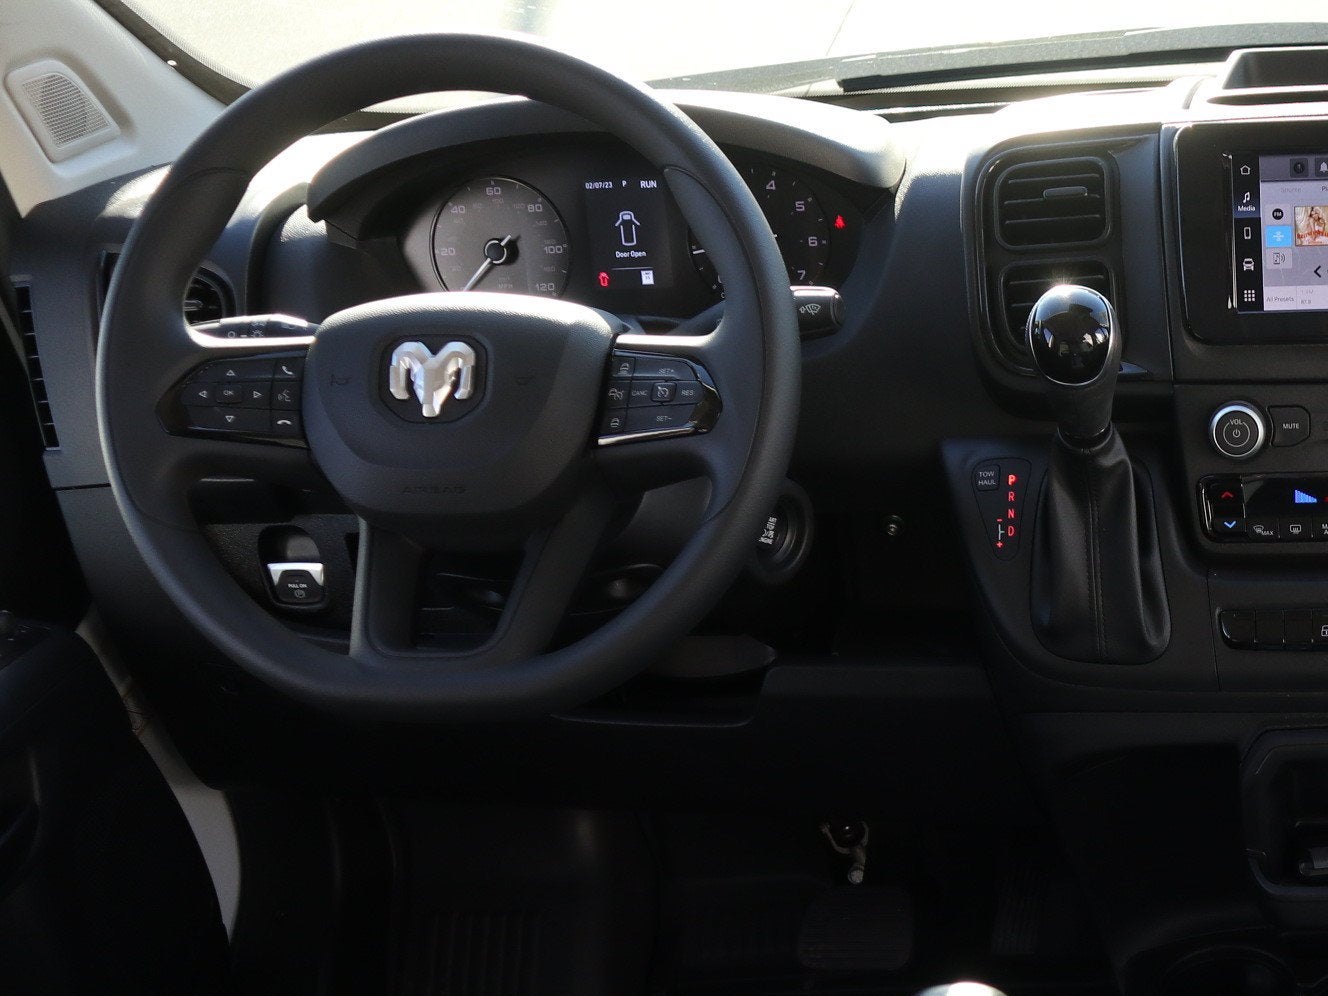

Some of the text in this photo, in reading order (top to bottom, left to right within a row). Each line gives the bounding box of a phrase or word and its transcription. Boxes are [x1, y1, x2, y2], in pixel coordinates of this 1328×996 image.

[585, 181, 613, 190] 02/07/23
[640, 180, 657, 189] RUN
[766, 180, 776, 190] 4
[485, 187, 501, 196] 60
[450, 206, 466, 214] 40
[527, 204, 543, 213] 80
[795, 201, 805, 212] 5
[808, 236, 818, 247] 6
[441, 248, 456, 256] 20
[544, 245, 563, 254] 100
[630, 250, 647, 258] Open
[797, 270, 806, 280] 7
[535, 283, 555, 291] 120
[1008, 475, 1017, 485] P
[1008, 491, 1015, 502] R
[1008, 509, 1015, 519] N
[1007, 525, 1015, 536] D
